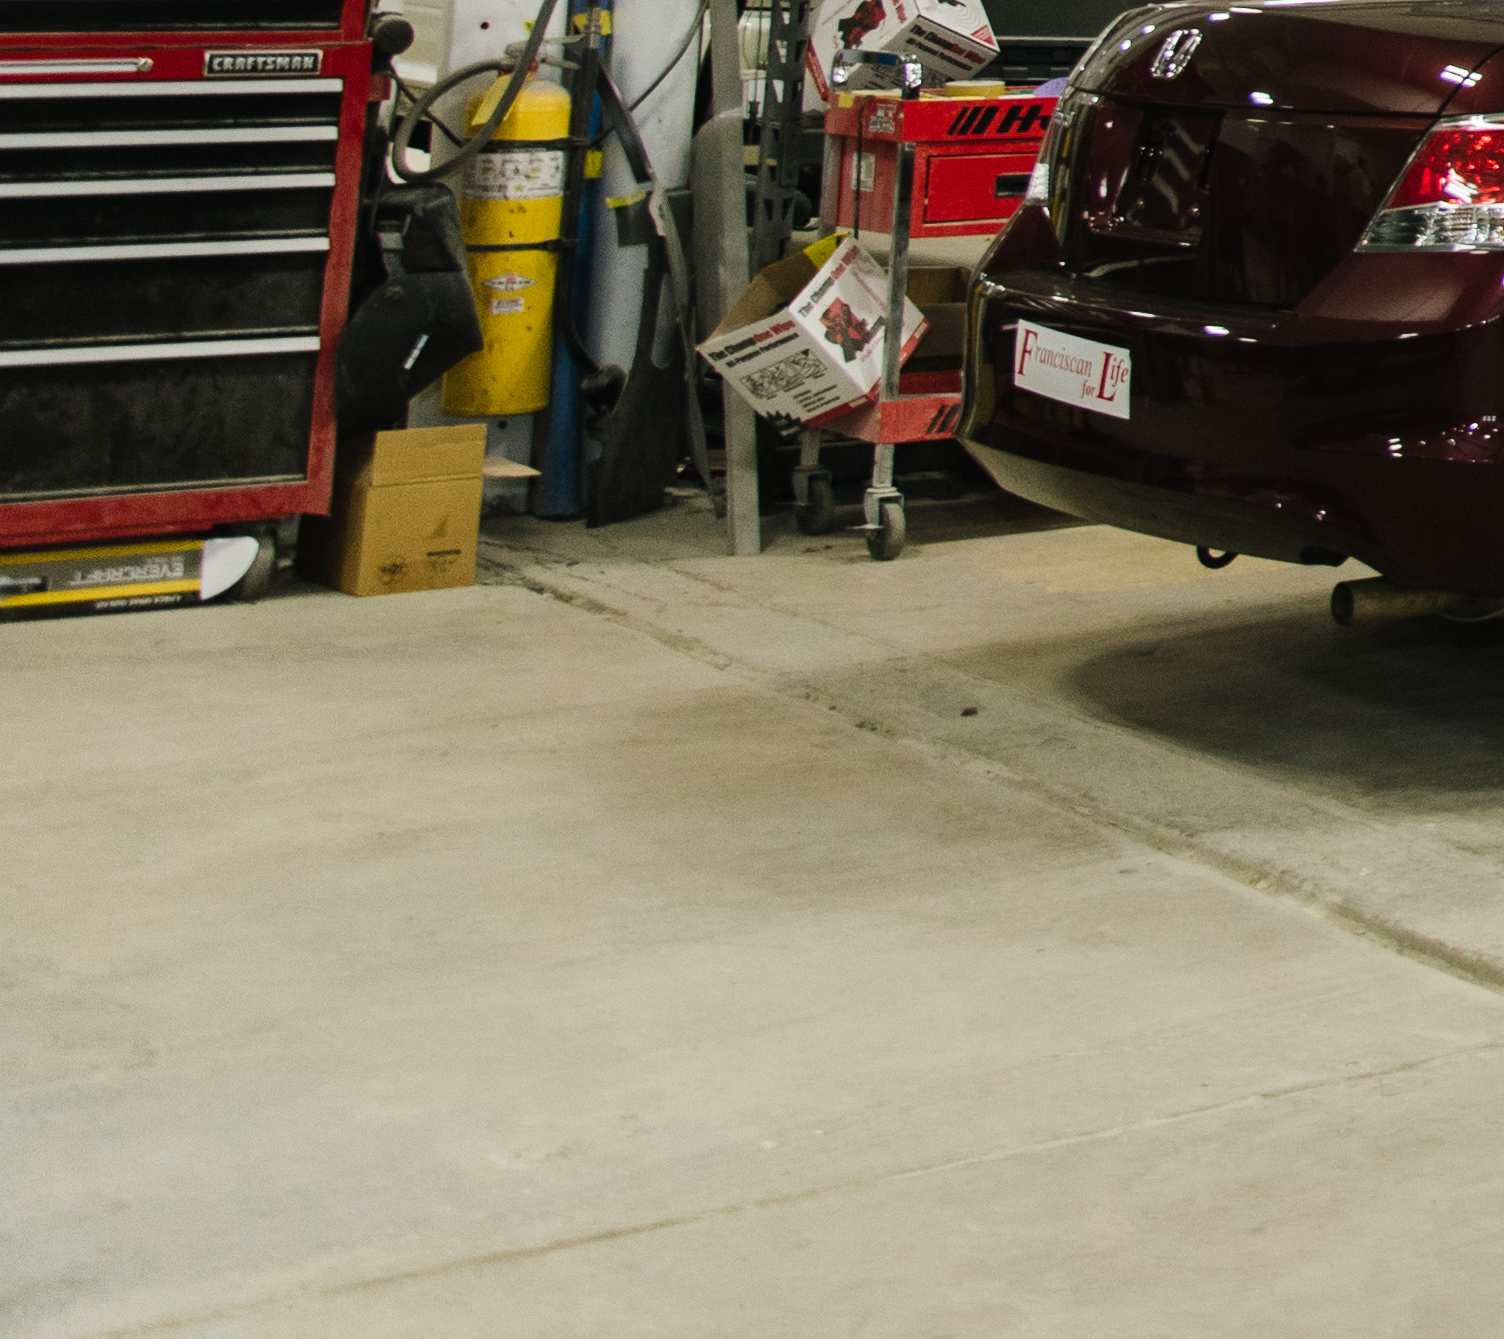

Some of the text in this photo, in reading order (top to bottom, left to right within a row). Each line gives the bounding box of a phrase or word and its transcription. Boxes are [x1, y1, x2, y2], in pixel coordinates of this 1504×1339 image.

[212, 55, 315, 71] CRAFTSMAN
[1017, 328, 1129, 402] Franciscan for Life
[70, 562, 184, 586] EVERCRAFT
